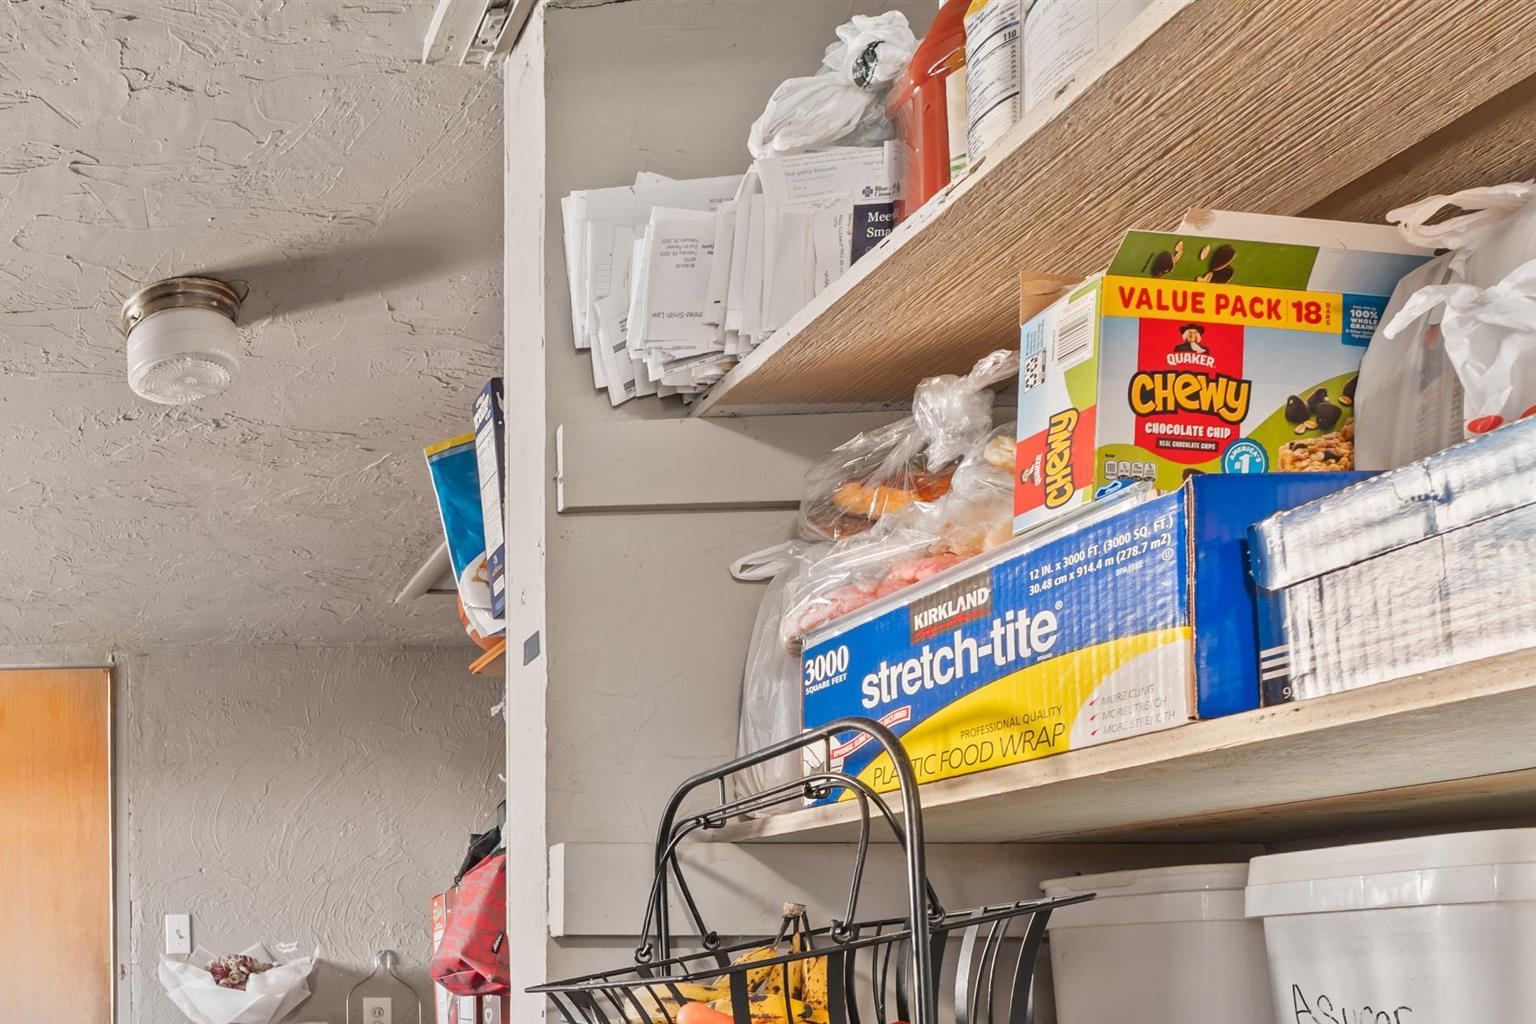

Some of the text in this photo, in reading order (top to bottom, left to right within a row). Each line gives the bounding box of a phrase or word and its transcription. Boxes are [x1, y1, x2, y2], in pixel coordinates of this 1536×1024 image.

[1118, 285, 1323, 325] VALUE PACK 18
[1350, 309, 1378, 319] 100%
[1166, 353, 1215, 368] QUAKER
[1145, 422, 1232, 439] CHOCOLATE CHIP
[1172, 440, 1200, 449] CHOCOLATE
[1234, 454, 1250, 473] #1
[1029, 569, 1040, 581] 12
[1041, 565, 1054, 576] IN.
[1063, 550, 1085, 568] 3000
[1087, 545, 1101, 559] FT.
[1103, 533, 1131, 554] (3000
[1133, 526, 1151, 540] SQ.
[1153, 512, 1174, 532] FT.)
[1028, 578, 1053, 596] 30.48
[1054, 575, 1067, 586] cm
[1076, 561, 1102, 578] 914.4
[1104, 558, 1114, 567] m
[1116, 542, 1148, 565] (278.7
[1150, 533, 1171, 549] m2)
[914, 587, 990, 630] KIRKLAND
[804, 645, 849, 686] 3000
[861, 608, 1058, 709] stretch-tite
[805, 672, 848, 695] SQUARE FEET
[1101, 691, 1126, 705] MORE
[960, 704, 1064, 740] PROFESSIONAL QUALITY
[1102, 706, 1126, 720] MORE
[873, 722, 1066, 787] PLATIC FOOD WRAP
